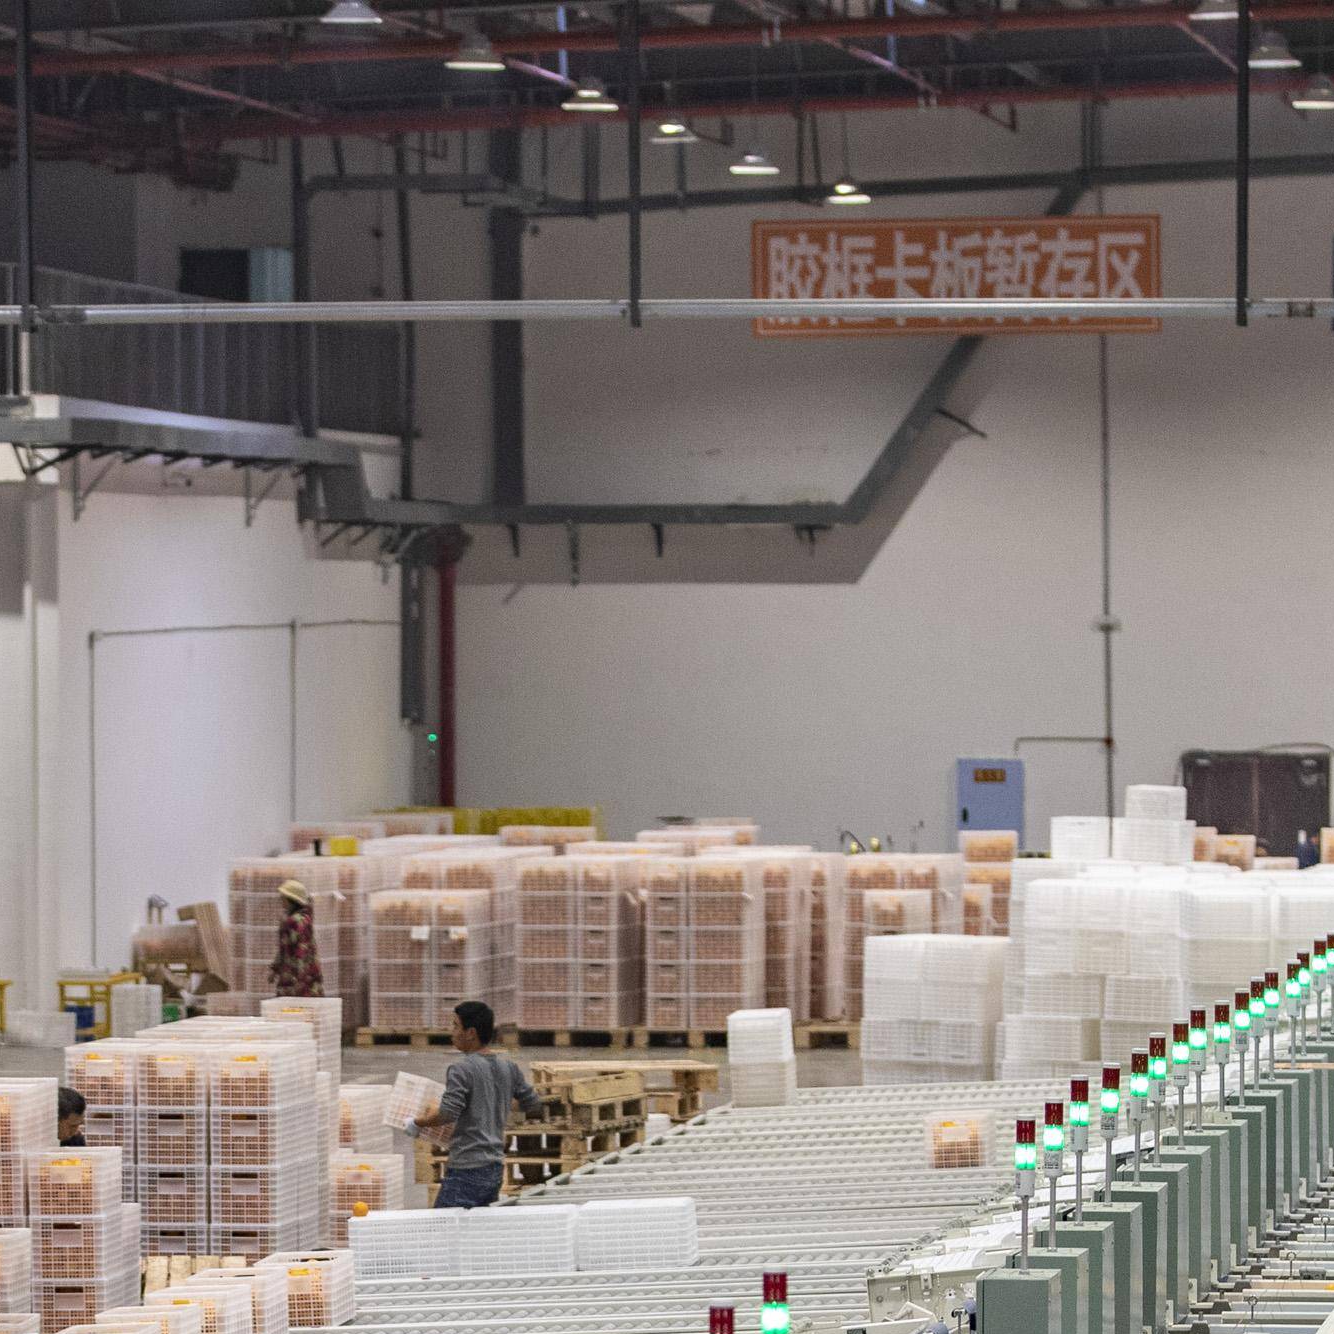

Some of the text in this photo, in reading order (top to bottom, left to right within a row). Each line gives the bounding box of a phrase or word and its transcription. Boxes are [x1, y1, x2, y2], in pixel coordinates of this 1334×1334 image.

[768, 229, 1145, 326] 胶框卡板暂存区
